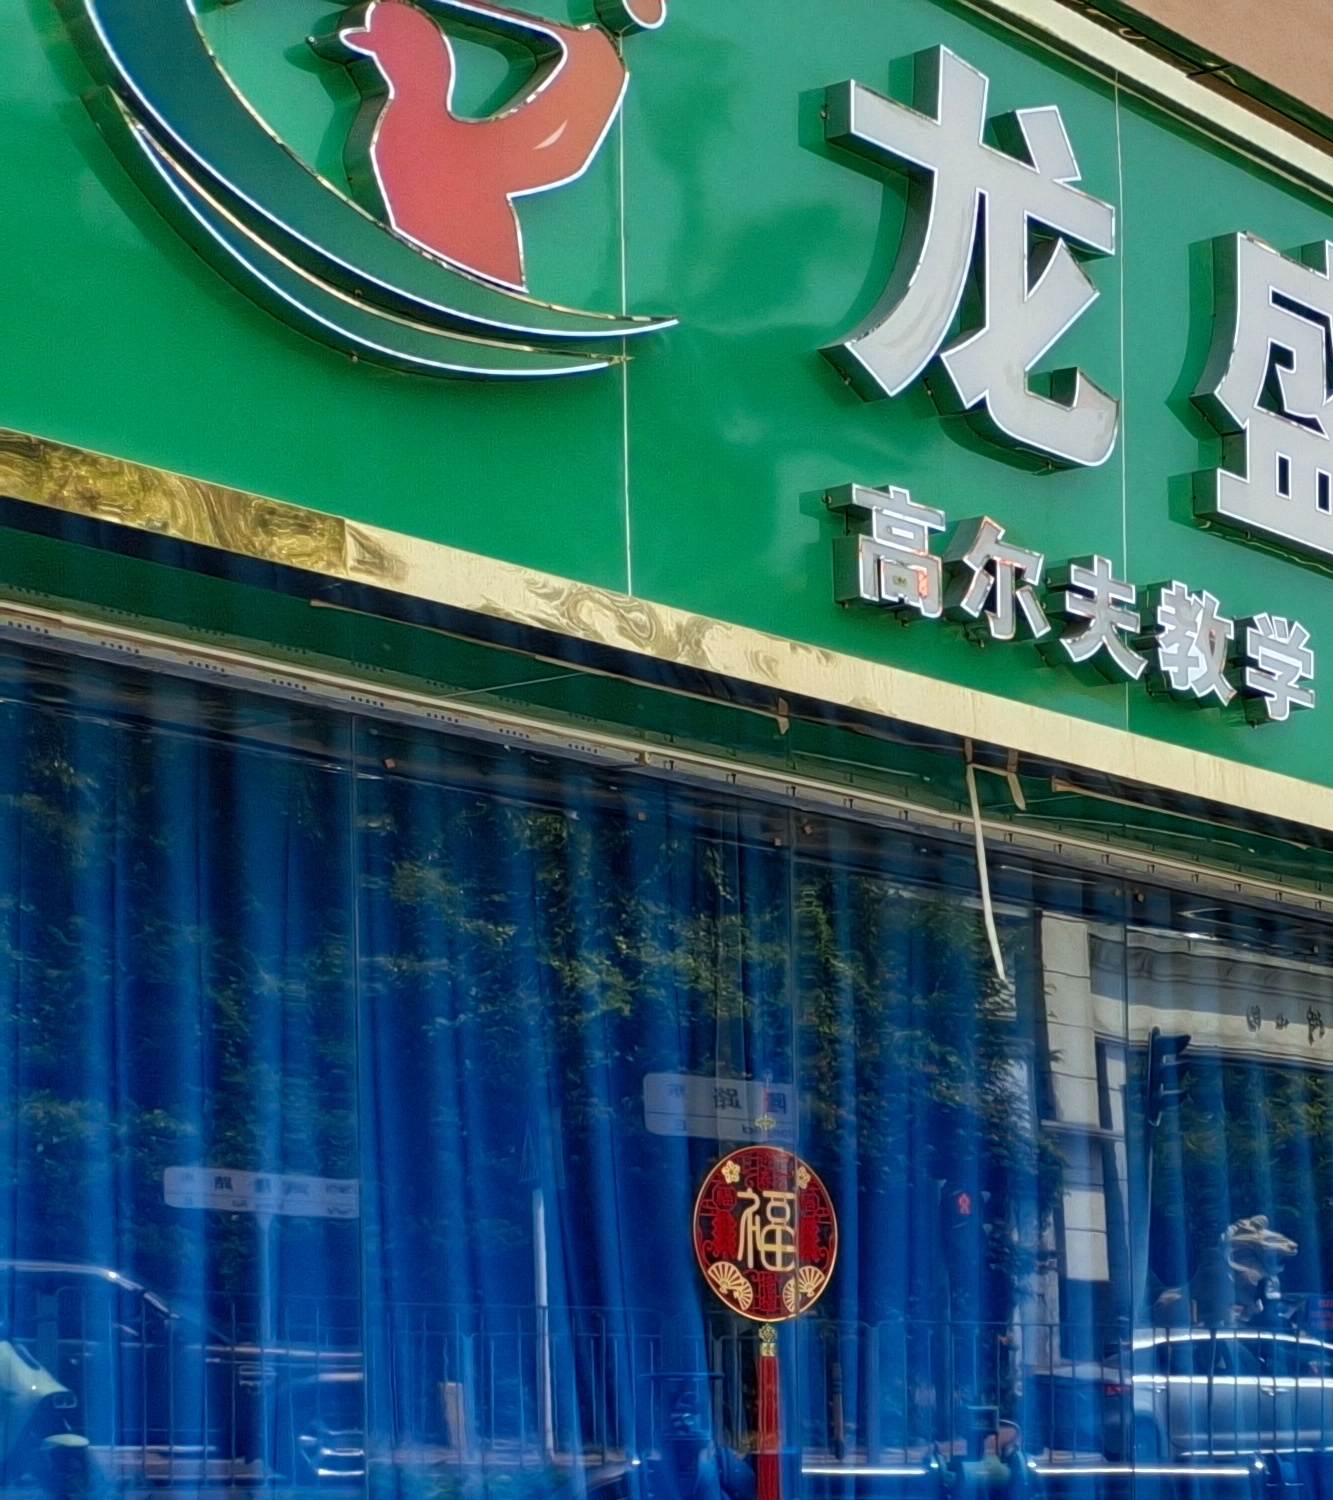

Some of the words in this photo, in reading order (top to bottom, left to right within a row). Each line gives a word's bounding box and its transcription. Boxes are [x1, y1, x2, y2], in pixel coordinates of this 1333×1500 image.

[851, 483, 1315, 721] 高尔夫教学
[737, 1187, 797, 1272] 福
